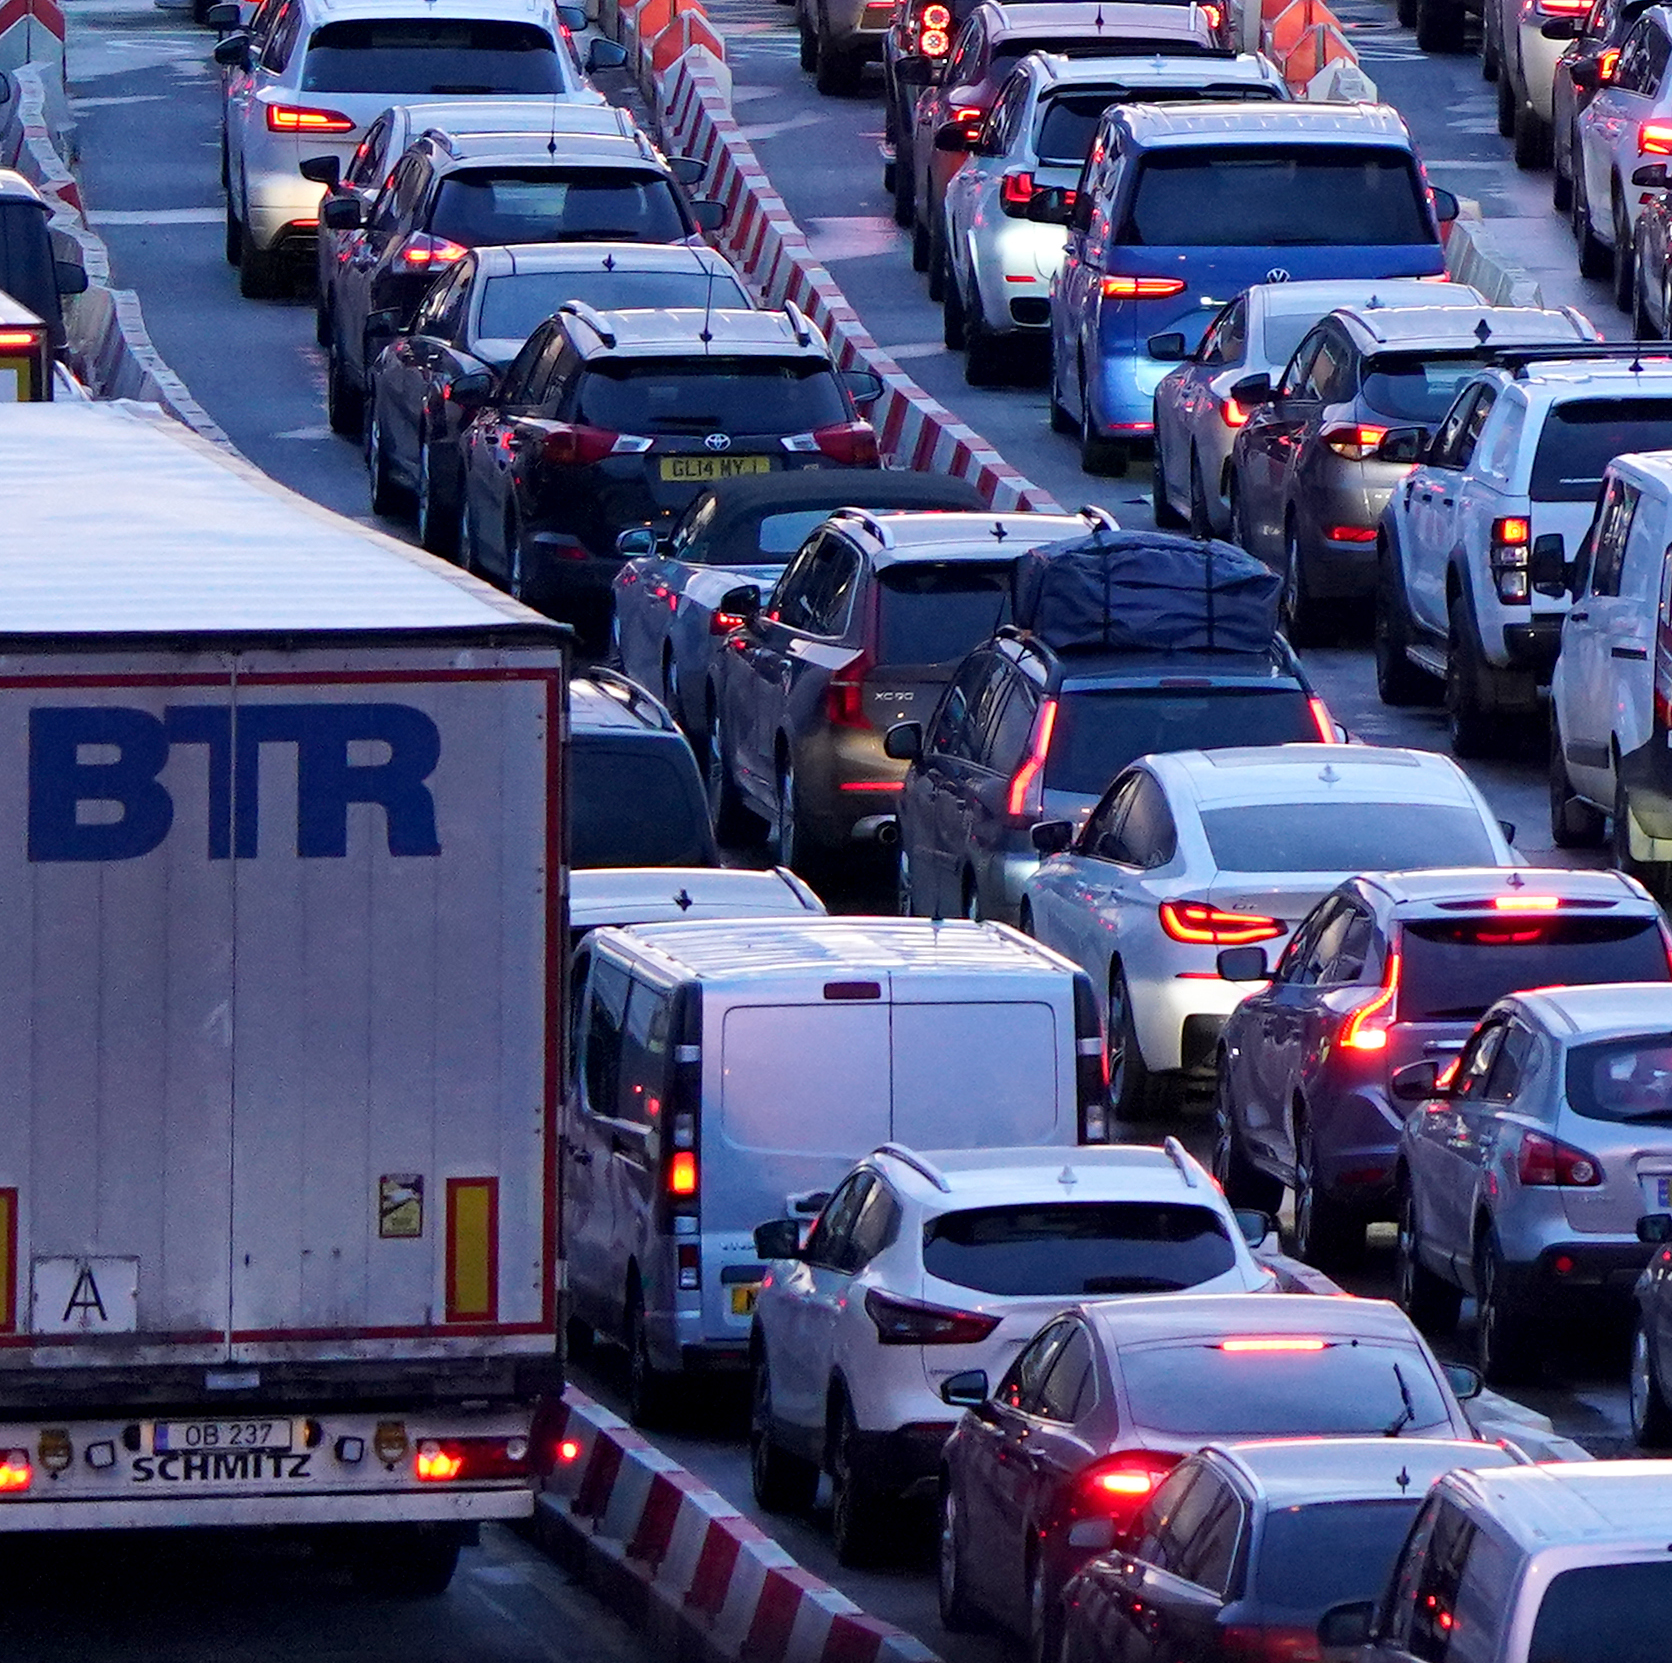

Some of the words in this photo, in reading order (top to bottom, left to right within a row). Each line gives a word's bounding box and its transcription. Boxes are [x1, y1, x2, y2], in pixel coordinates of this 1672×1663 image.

[27, 702, 442, 862] BTR
[62, 1268, 107, 1322] A
[185, 1424, 220, 1449] OB
[230, 1422, 272, 1447] 237
[132, 1453, 311, 1484] SCHMITZ
